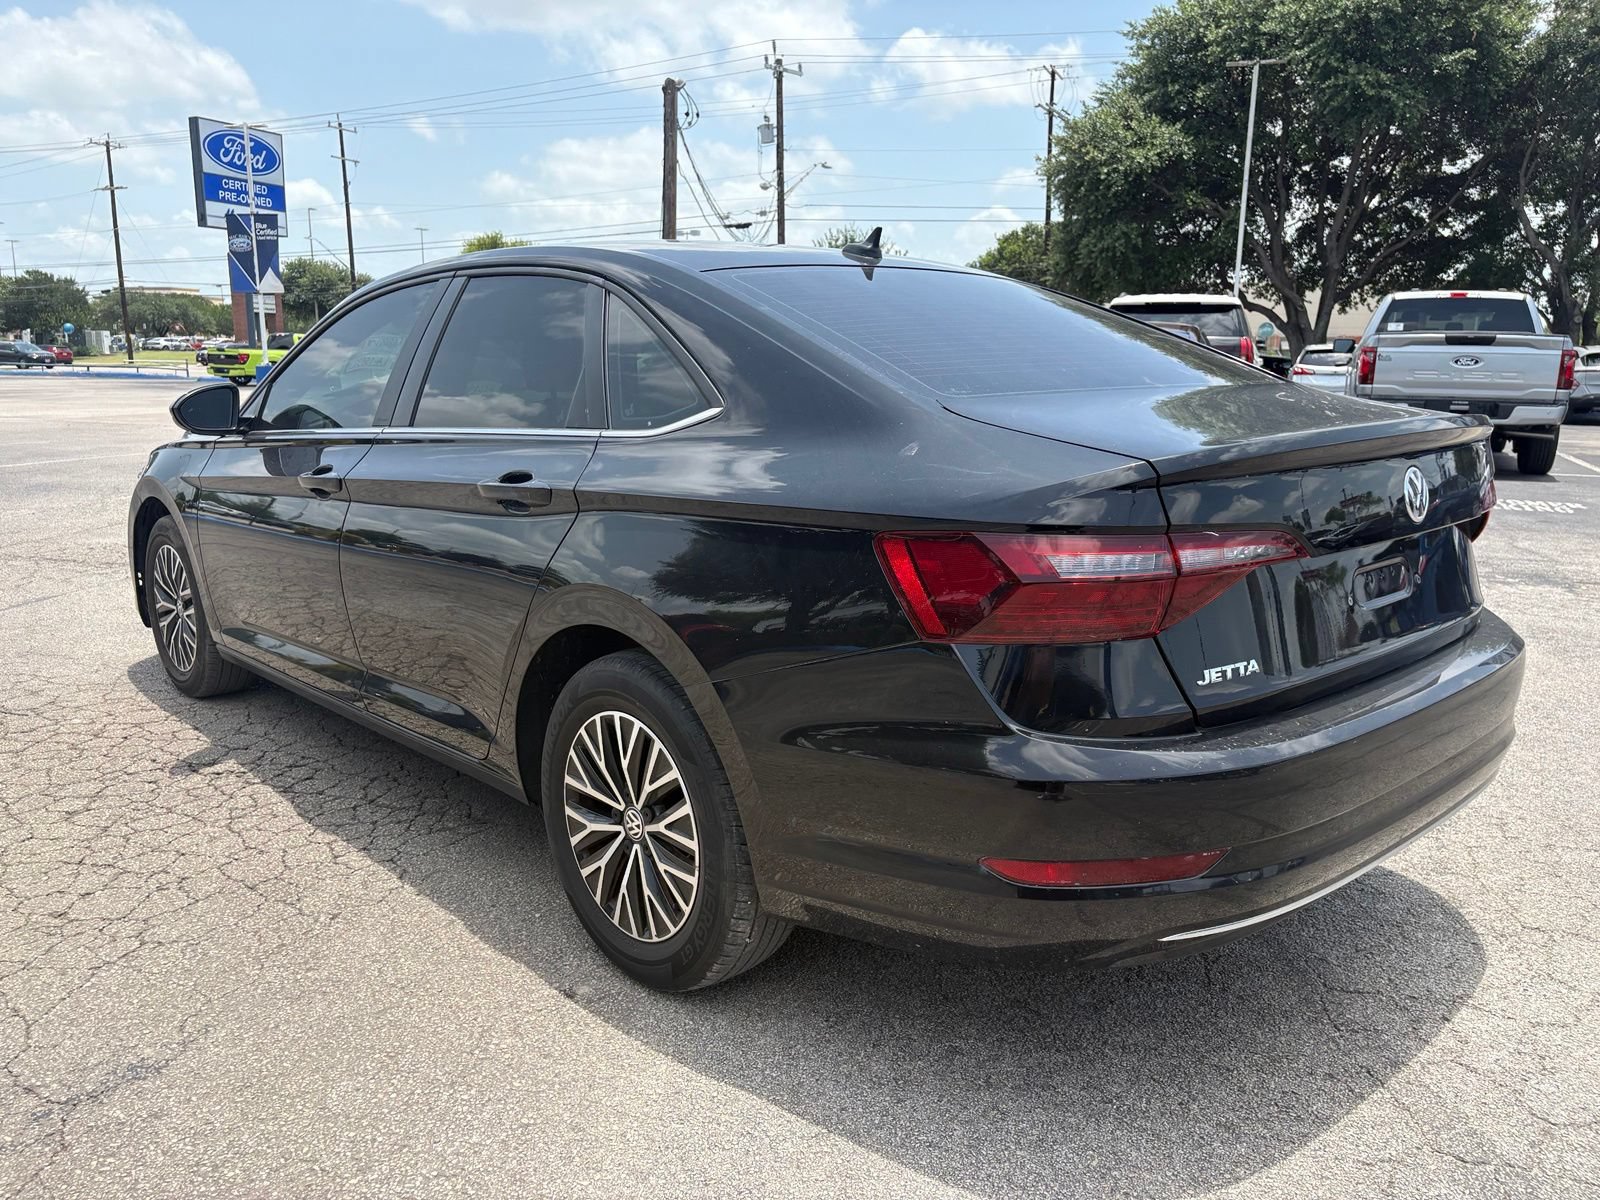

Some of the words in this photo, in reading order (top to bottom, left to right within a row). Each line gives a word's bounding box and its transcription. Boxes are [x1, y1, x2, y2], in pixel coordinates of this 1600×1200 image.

[221, 178, 268, 195] CERTIIED
[1457, 356, 1477, 366] Ford
[1196, 659, 1261, 686] JETTA
